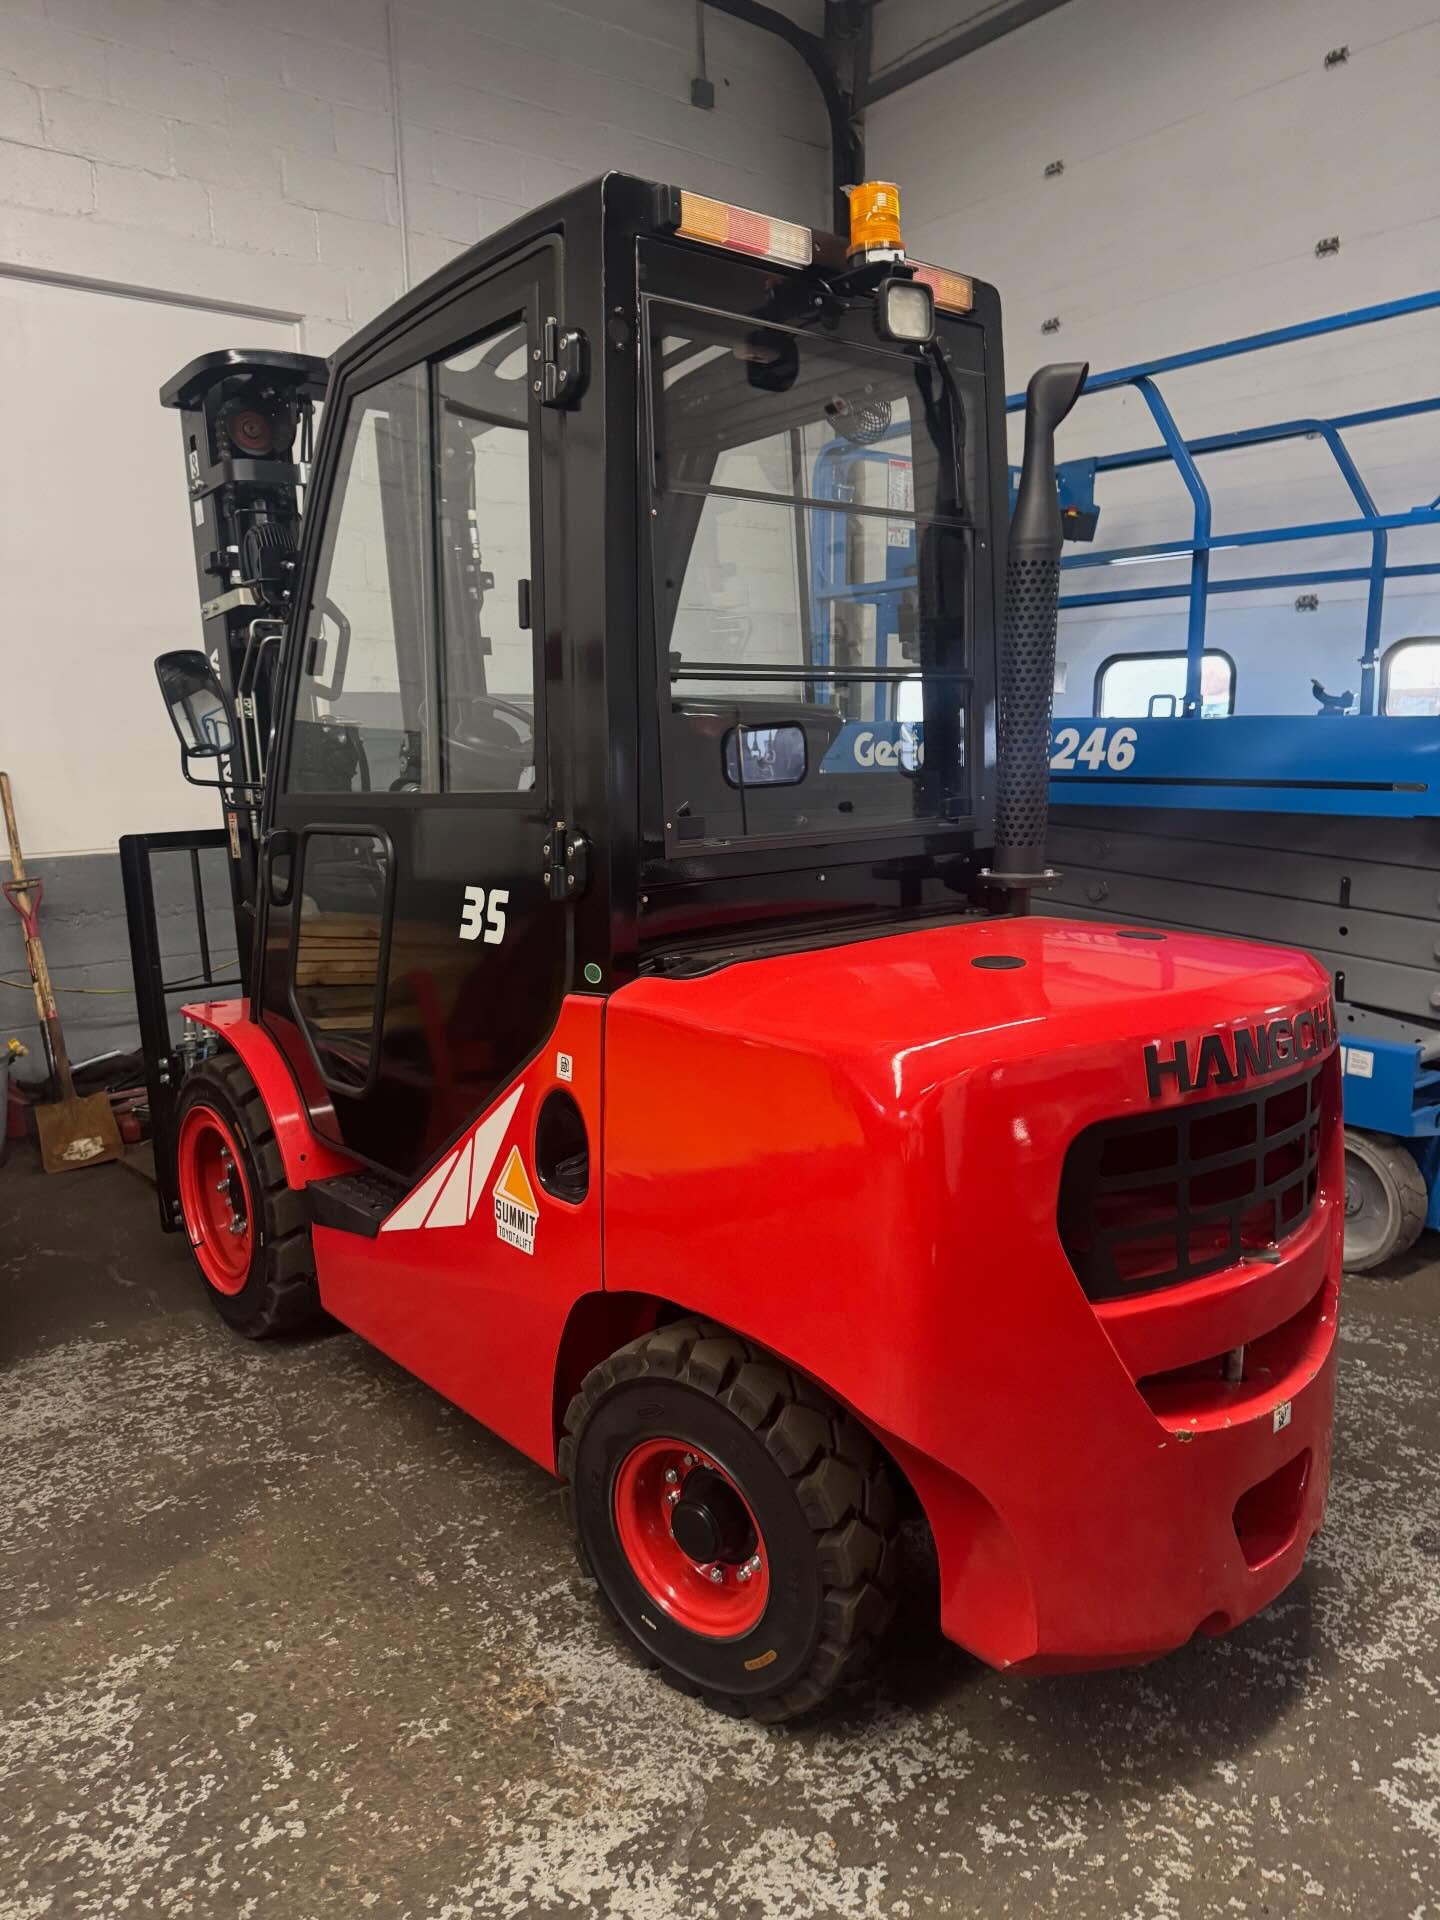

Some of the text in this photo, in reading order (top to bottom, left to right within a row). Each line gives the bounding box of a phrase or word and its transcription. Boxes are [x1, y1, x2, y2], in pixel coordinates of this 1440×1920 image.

[459, 886, 510, 945] 35
[495, 1199, 536, 1237] SUMMIT
[498, 1225, 532, 1252] TOYOTALIFT
